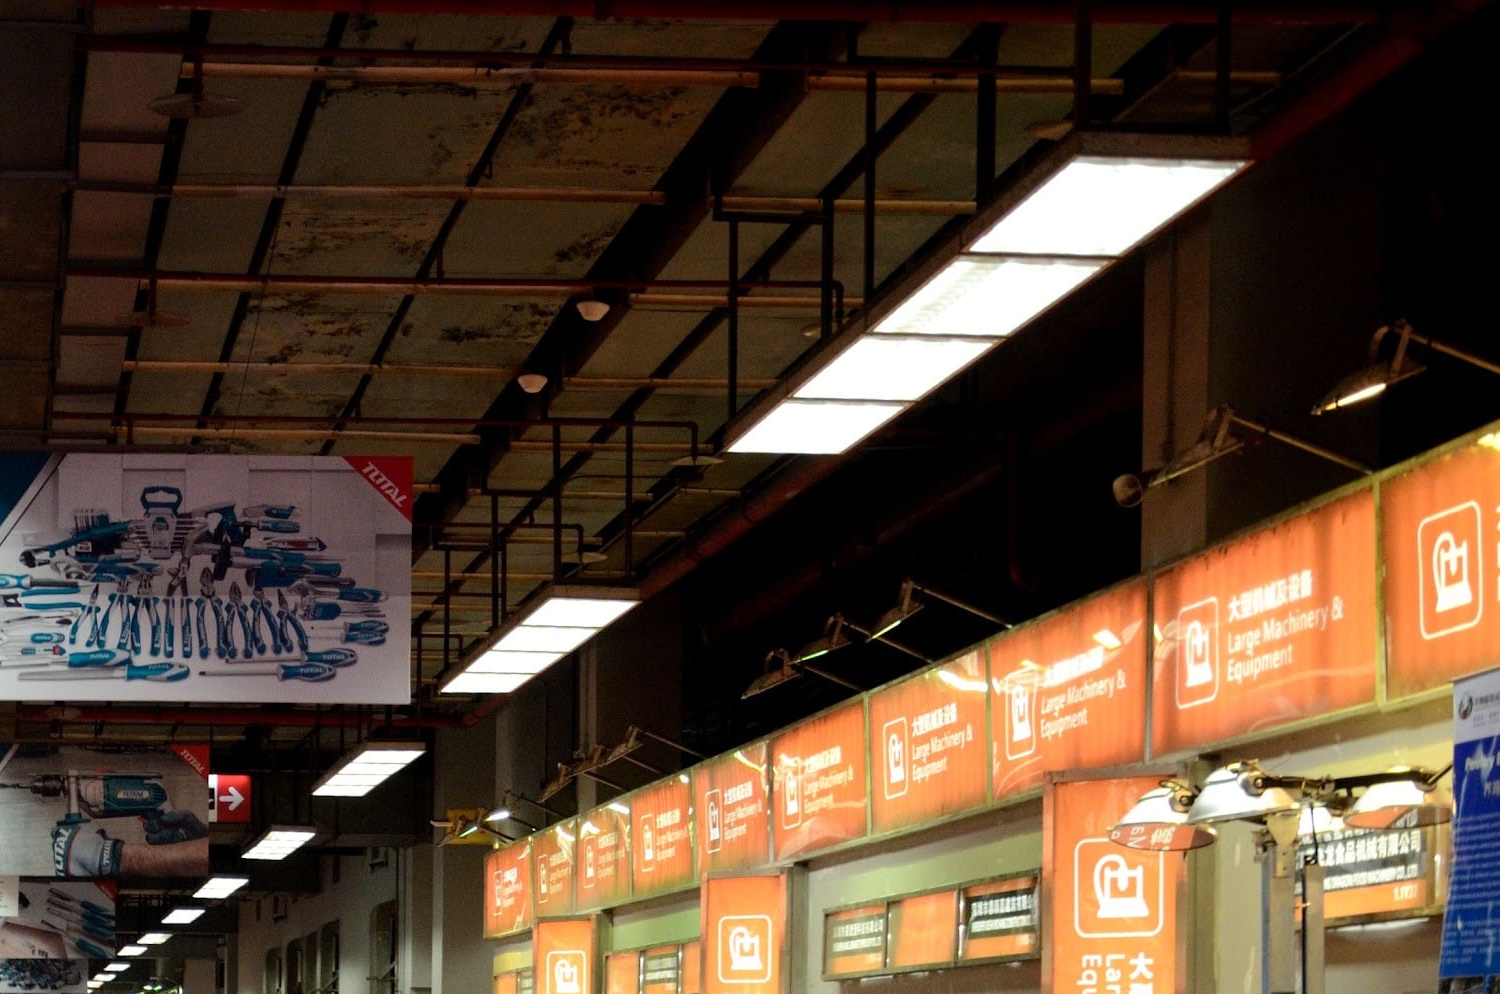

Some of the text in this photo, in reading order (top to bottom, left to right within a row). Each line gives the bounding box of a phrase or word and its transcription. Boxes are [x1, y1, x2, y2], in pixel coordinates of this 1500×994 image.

[361, 461, 408, 507] TOTAL
[1227, 596, 1344, 656] Large Machinery &
[1227, 644, 1293, 683] Equipment
[1040, 692, 1066, 717] Large
[1066, 675, 1115, 706] Machinery
[1040, 707, 1088, 740] Equipment
